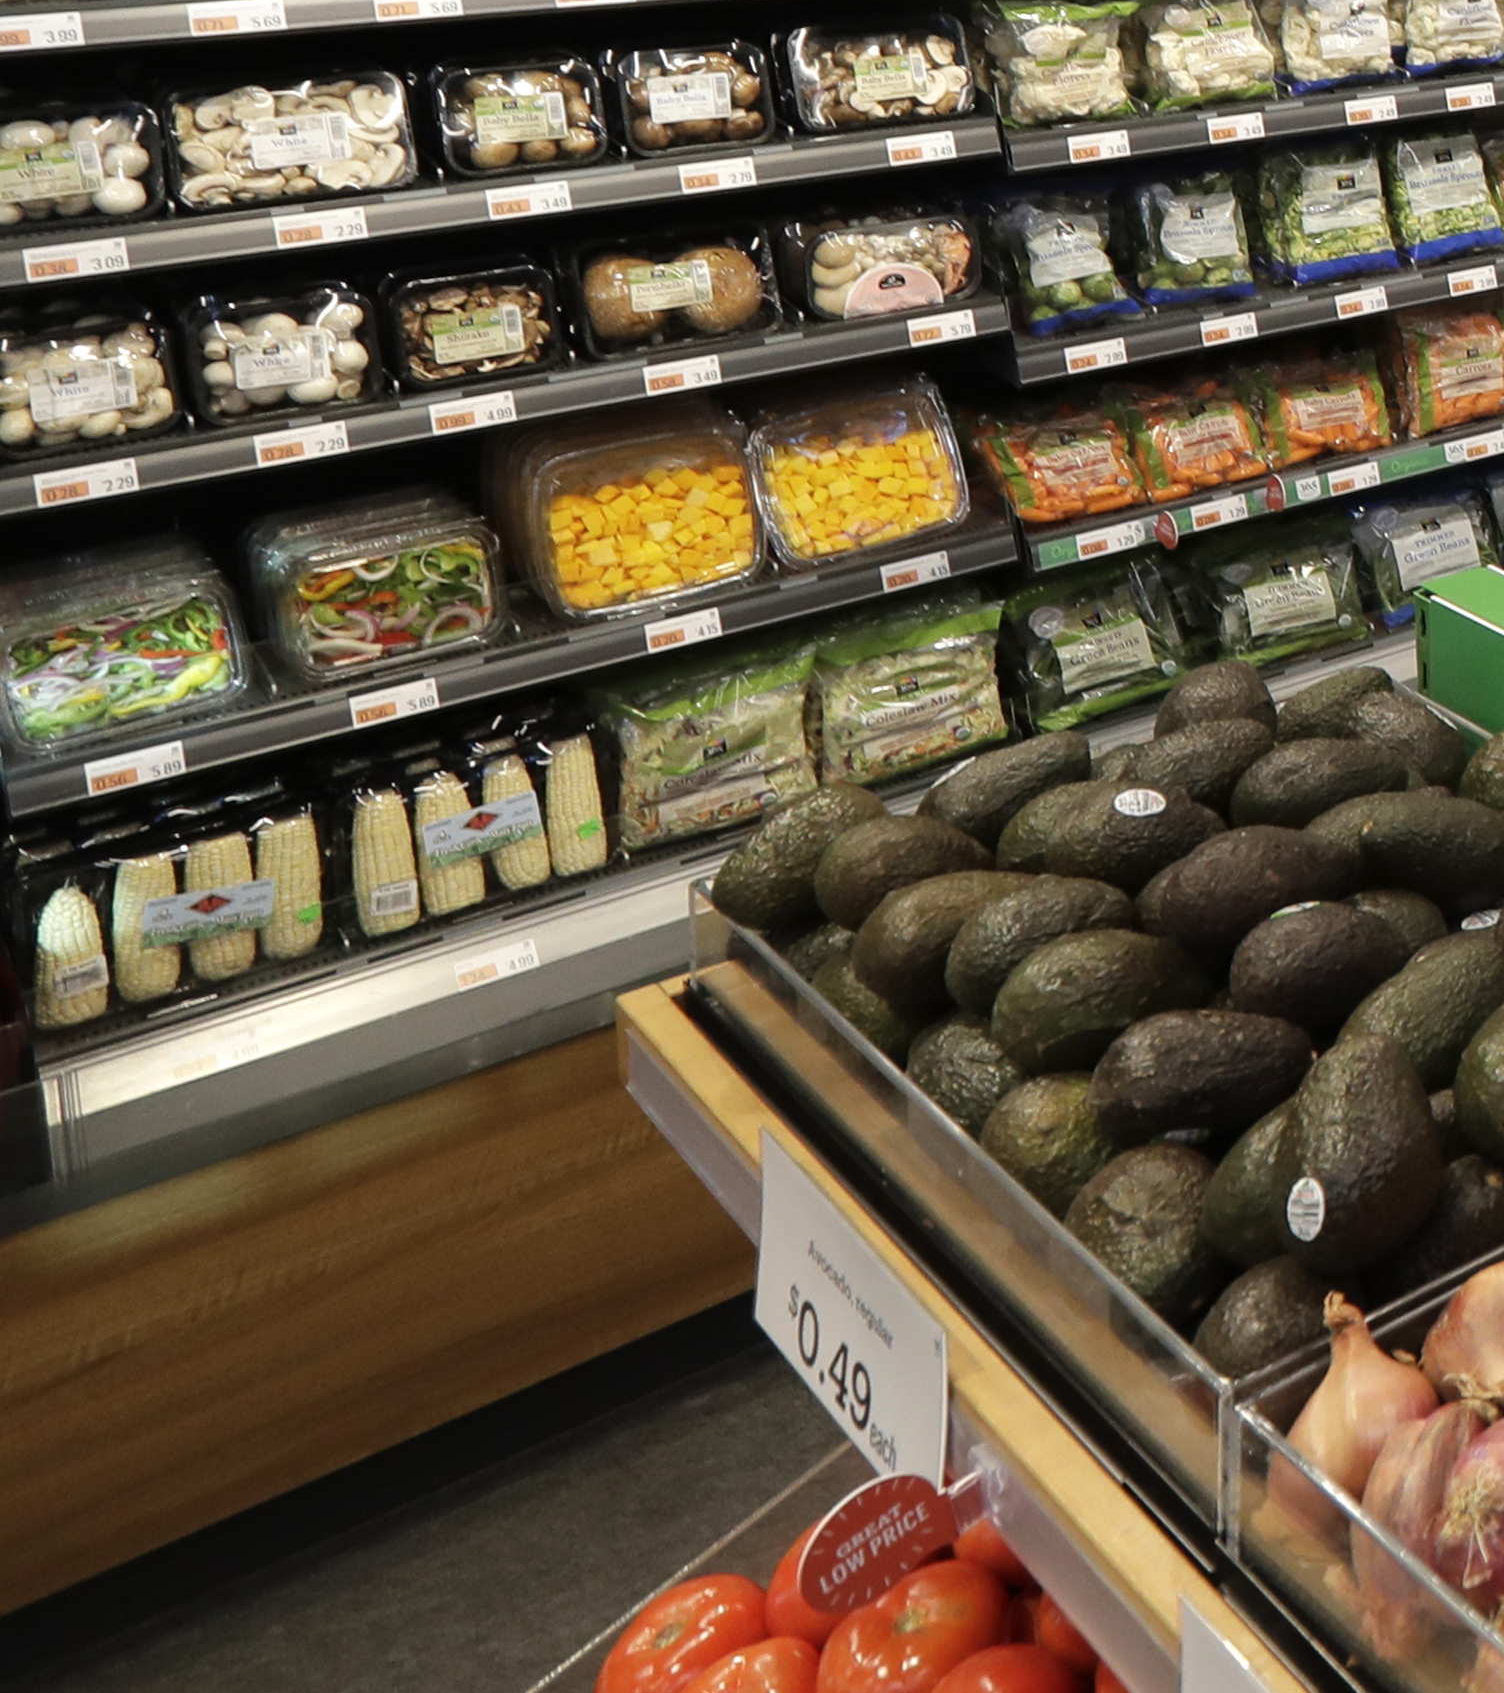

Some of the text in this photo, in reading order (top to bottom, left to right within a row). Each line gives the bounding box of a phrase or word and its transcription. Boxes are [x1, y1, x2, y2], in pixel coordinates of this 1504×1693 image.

[1403, 536, 1471, 565] Green Beans
[928, 691, 958, 707] Mix
[787, 1282, 898, 1472] $0.49 each
[818, 1499, 932, 1596] LOW PRICE
[834, 1501, 905, 1560] GREAT
